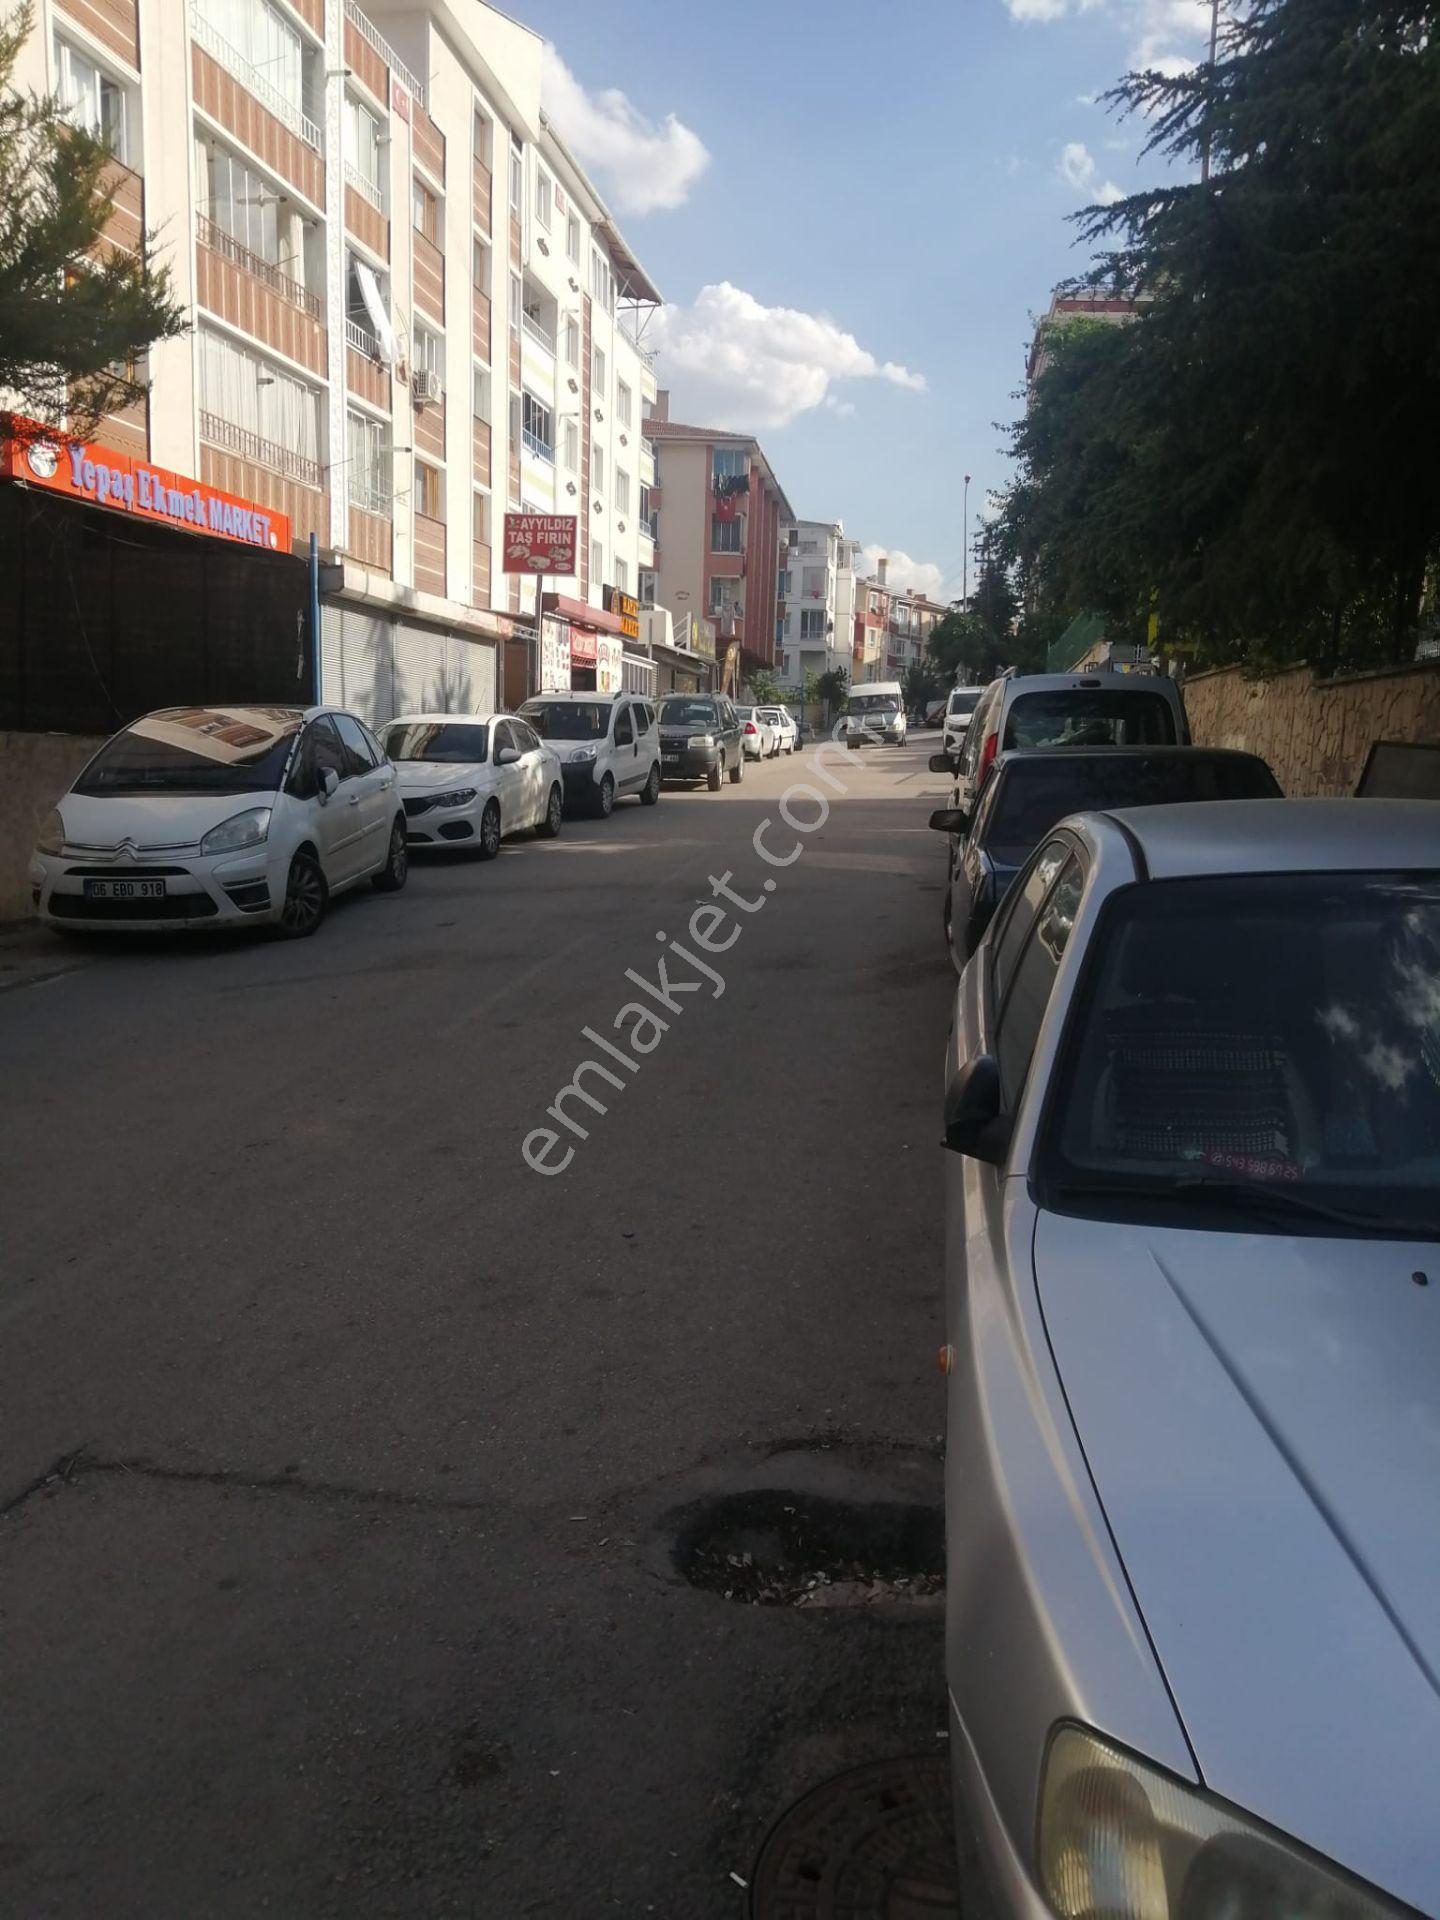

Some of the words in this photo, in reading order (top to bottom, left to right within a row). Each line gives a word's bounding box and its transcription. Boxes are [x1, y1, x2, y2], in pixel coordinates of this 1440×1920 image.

[137, 469, 207, 526] Ekmek
[208, 497, 271, 546] MARKET
[520, 517, 574, 531] AYYILDIZ
[508, 531, 533, 547] TAŞ
[536, 532, 572, 545] FIRIN
[93, 883, 106, 896] 06
